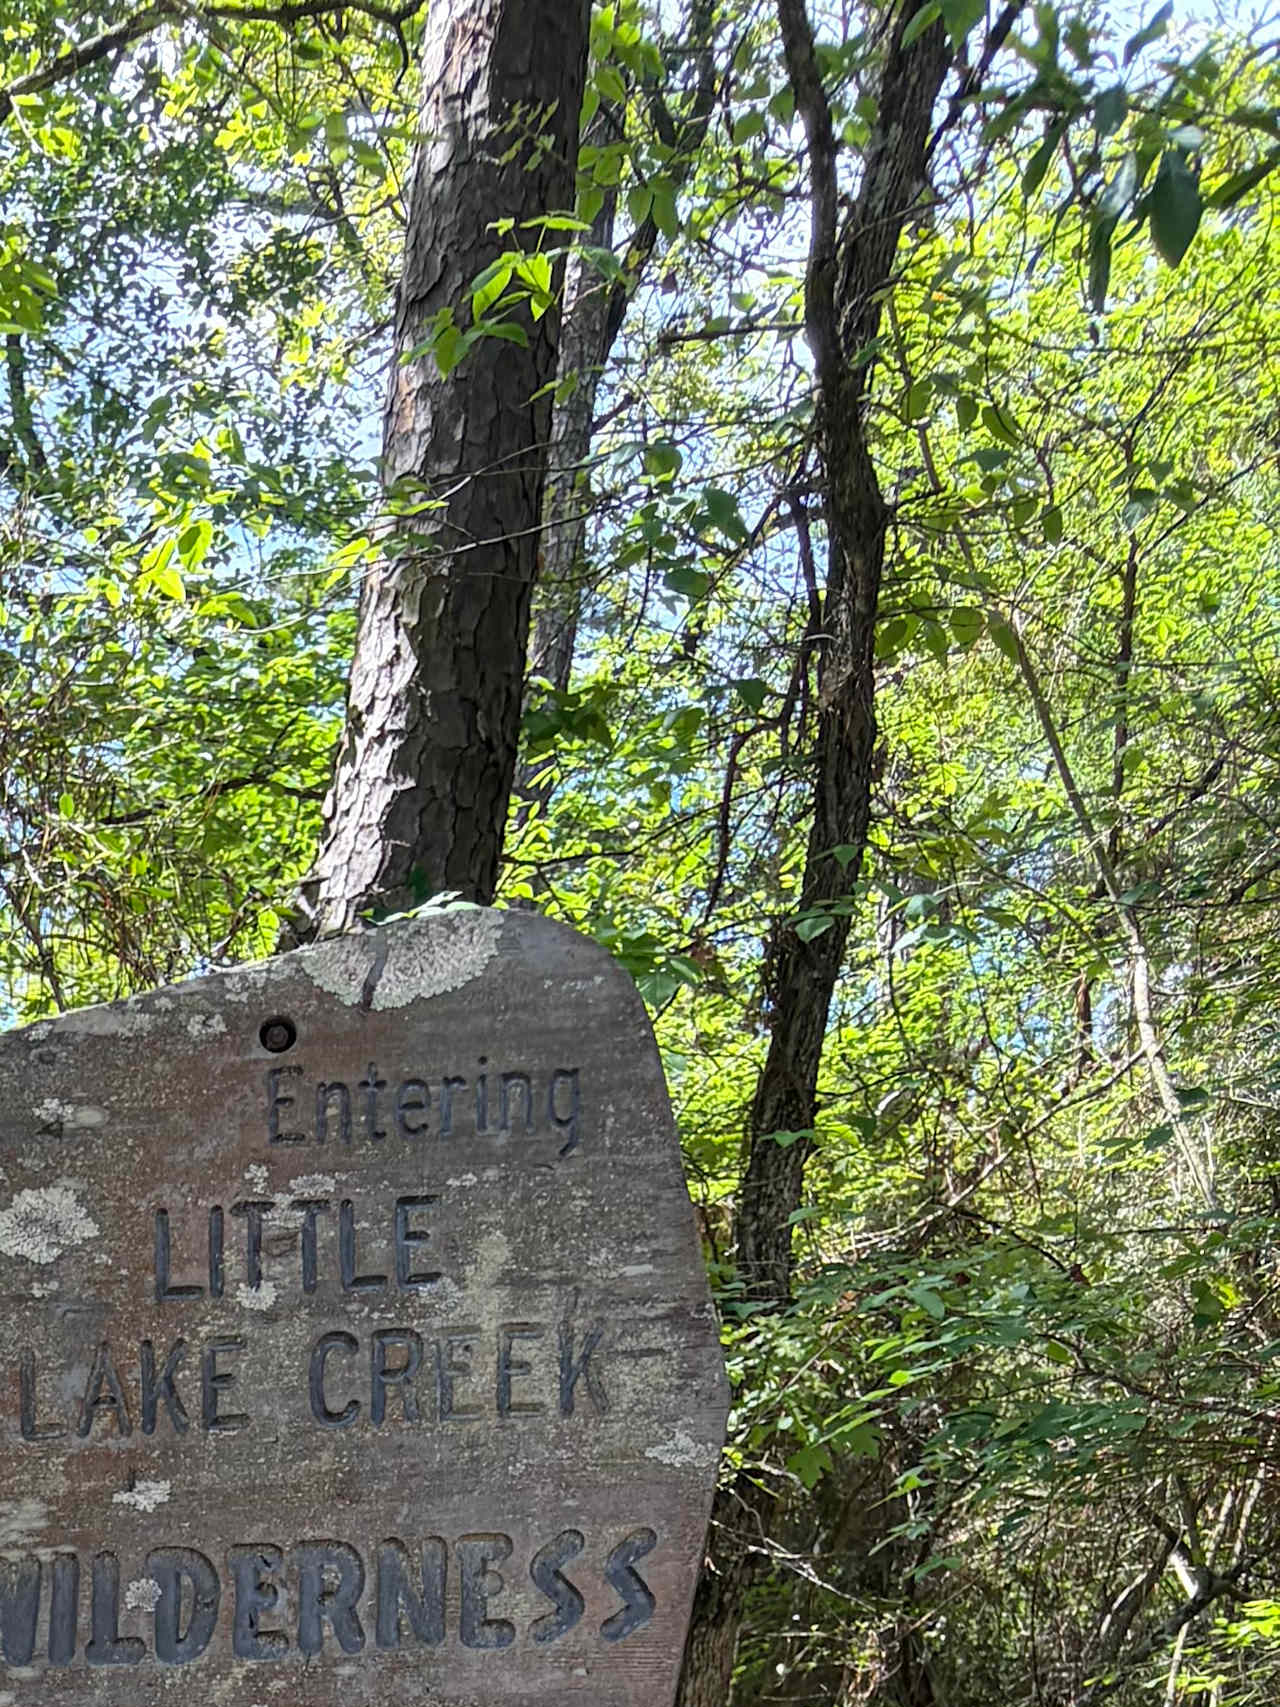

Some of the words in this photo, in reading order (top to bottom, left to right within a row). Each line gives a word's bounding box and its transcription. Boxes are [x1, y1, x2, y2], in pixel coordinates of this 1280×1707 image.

[268, 1057, 583, 1158] Entering
[154, 1195, 444, 1303] LITTLE
[17, 1333, 249, 1443] LAKE
[308, 1320, 615, 1431] CREEK
